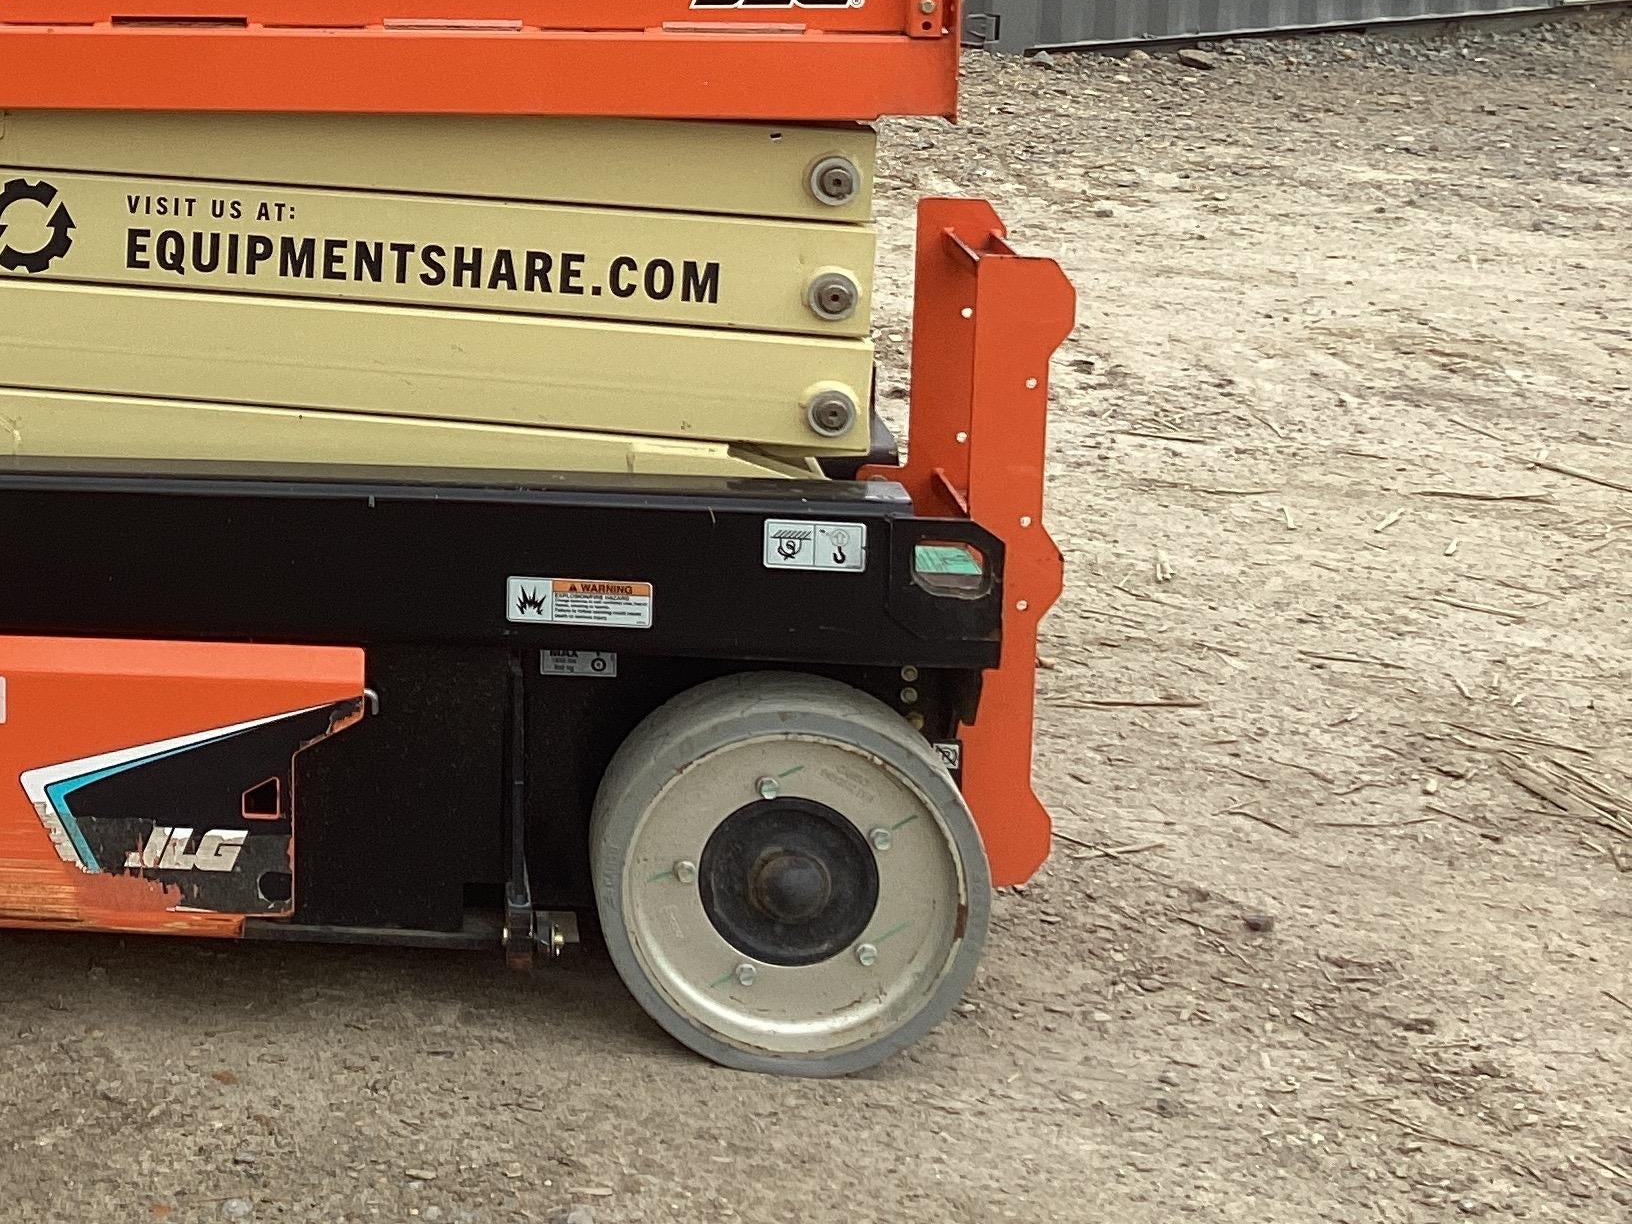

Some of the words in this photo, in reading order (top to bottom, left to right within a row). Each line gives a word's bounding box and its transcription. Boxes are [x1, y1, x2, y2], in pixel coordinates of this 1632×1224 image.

[126, 194, 198, 218] VISIT
[210, 199, 243, 219] US
[256, 201, 297, 222] AT:
[125, 227, 721, 305] EQUIPMENTSHARE.COM
[581, 583, 633, 595] WARNING
[123, 826, 249, 873] JLG
